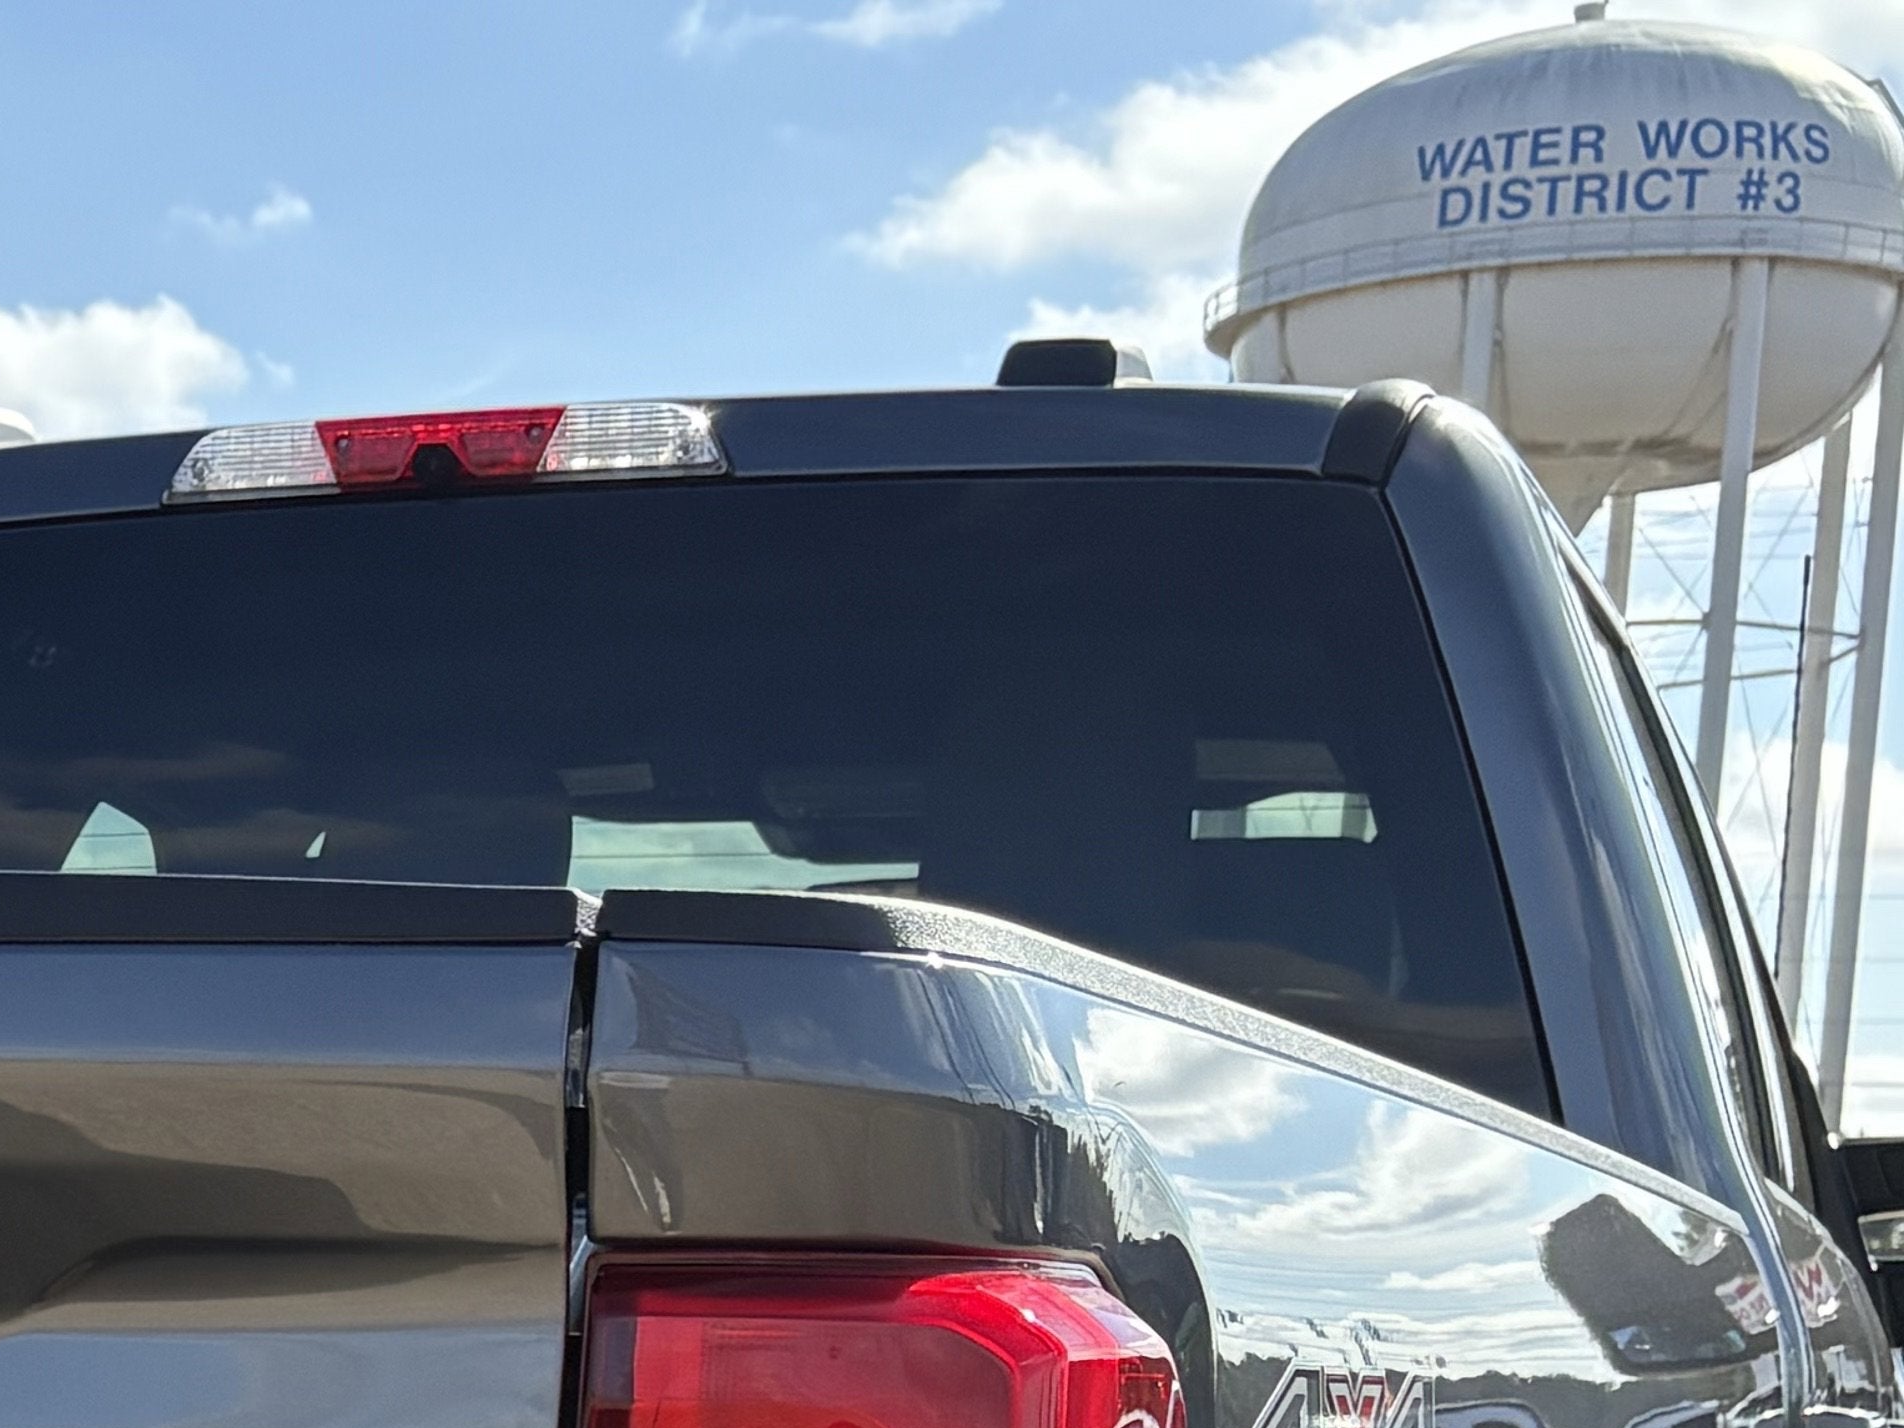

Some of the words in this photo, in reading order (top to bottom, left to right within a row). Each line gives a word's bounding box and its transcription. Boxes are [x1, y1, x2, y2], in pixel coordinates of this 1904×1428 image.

[1417, 124, 1607, 182] WATER
[1637, 118, 1831, 165] WORKS
[1437, 167, 1710, 229] DISTRICT
[1736, 170, 1803, 214] #3
